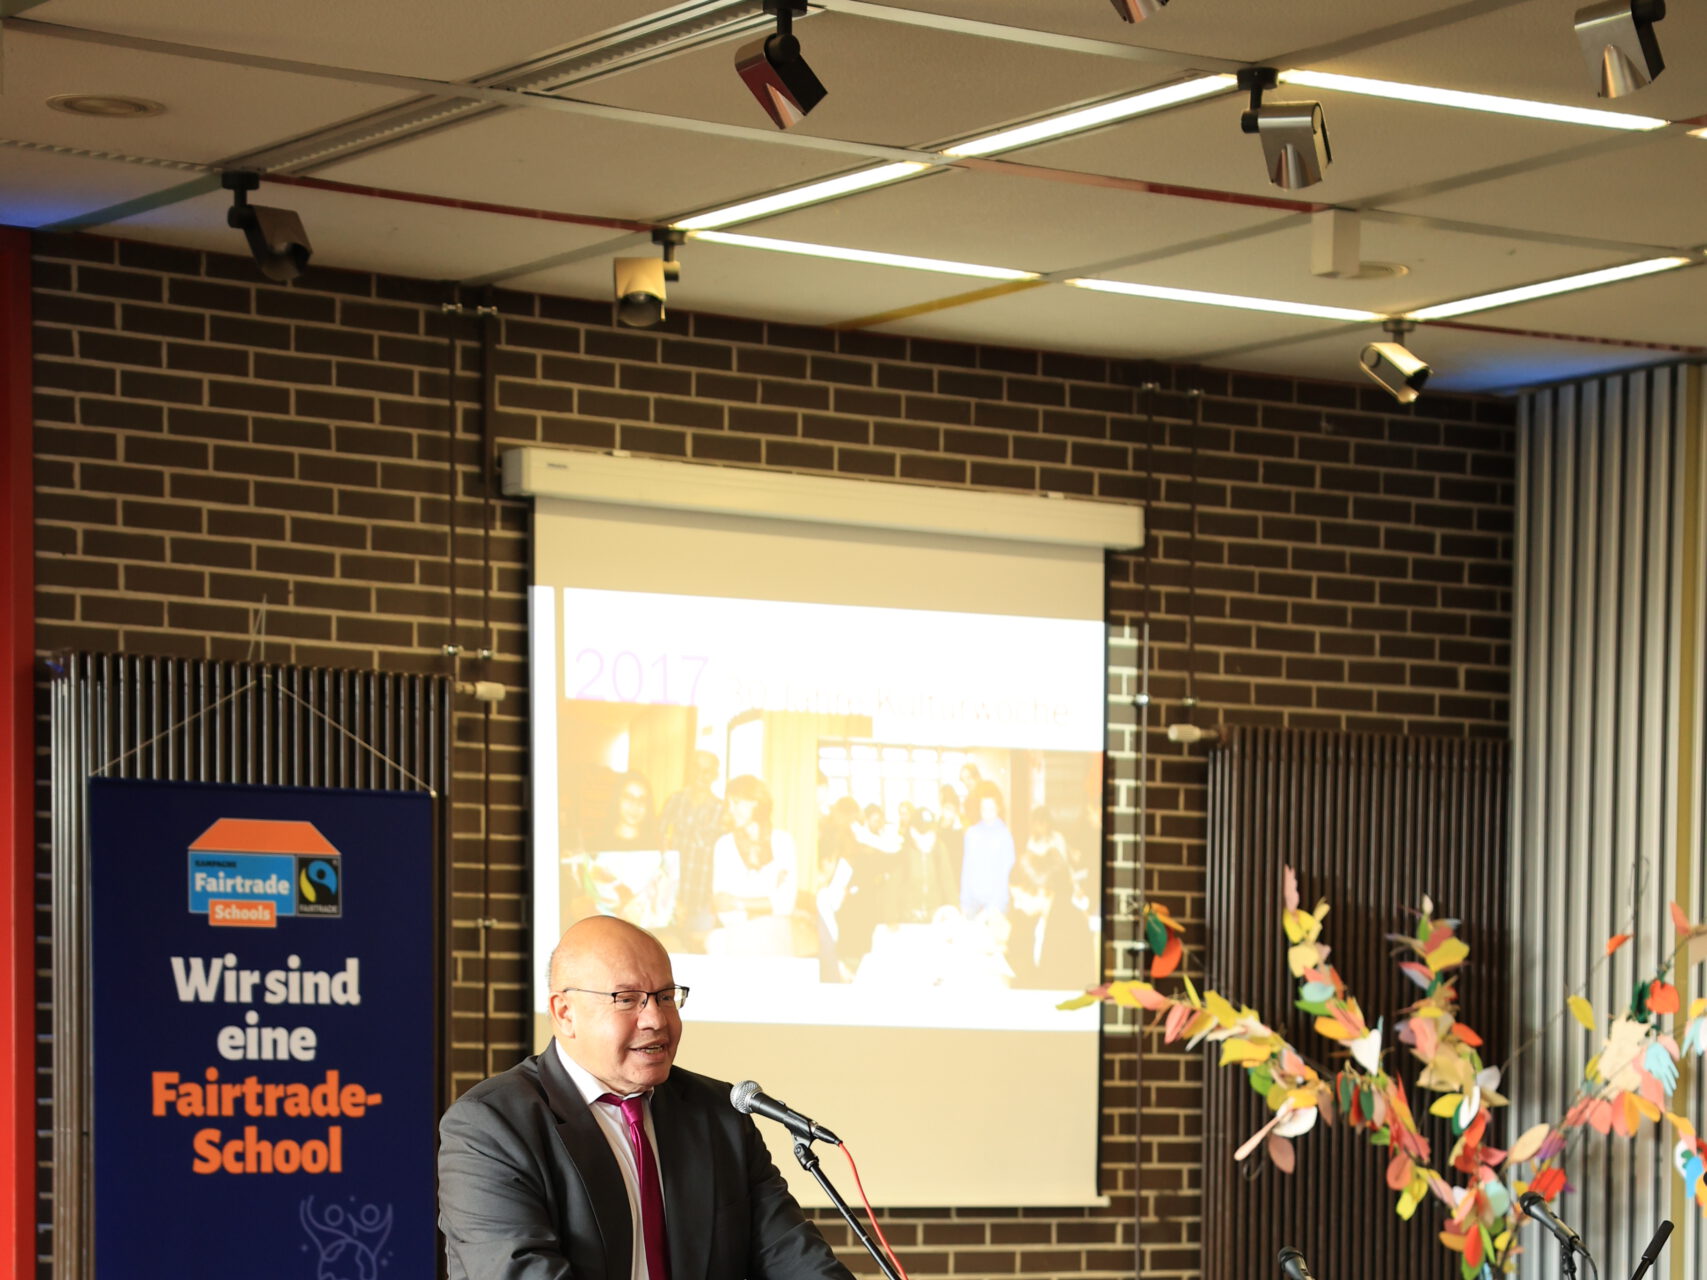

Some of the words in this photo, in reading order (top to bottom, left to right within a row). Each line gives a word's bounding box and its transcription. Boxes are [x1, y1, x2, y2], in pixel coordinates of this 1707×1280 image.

[575, 648, 710, 706] 2017
[195, 871, 291, 896] Fairtrade
[214, 904, 272, 921] Schools
[170, 952, 261, 1003] Wir
[264, 954, 362, 1006] sind
[216, 1009, 318, 1062] eine
[151, 1066, 383, 1118] Fairtrade-
[192, 1125, 343, 1175] School
